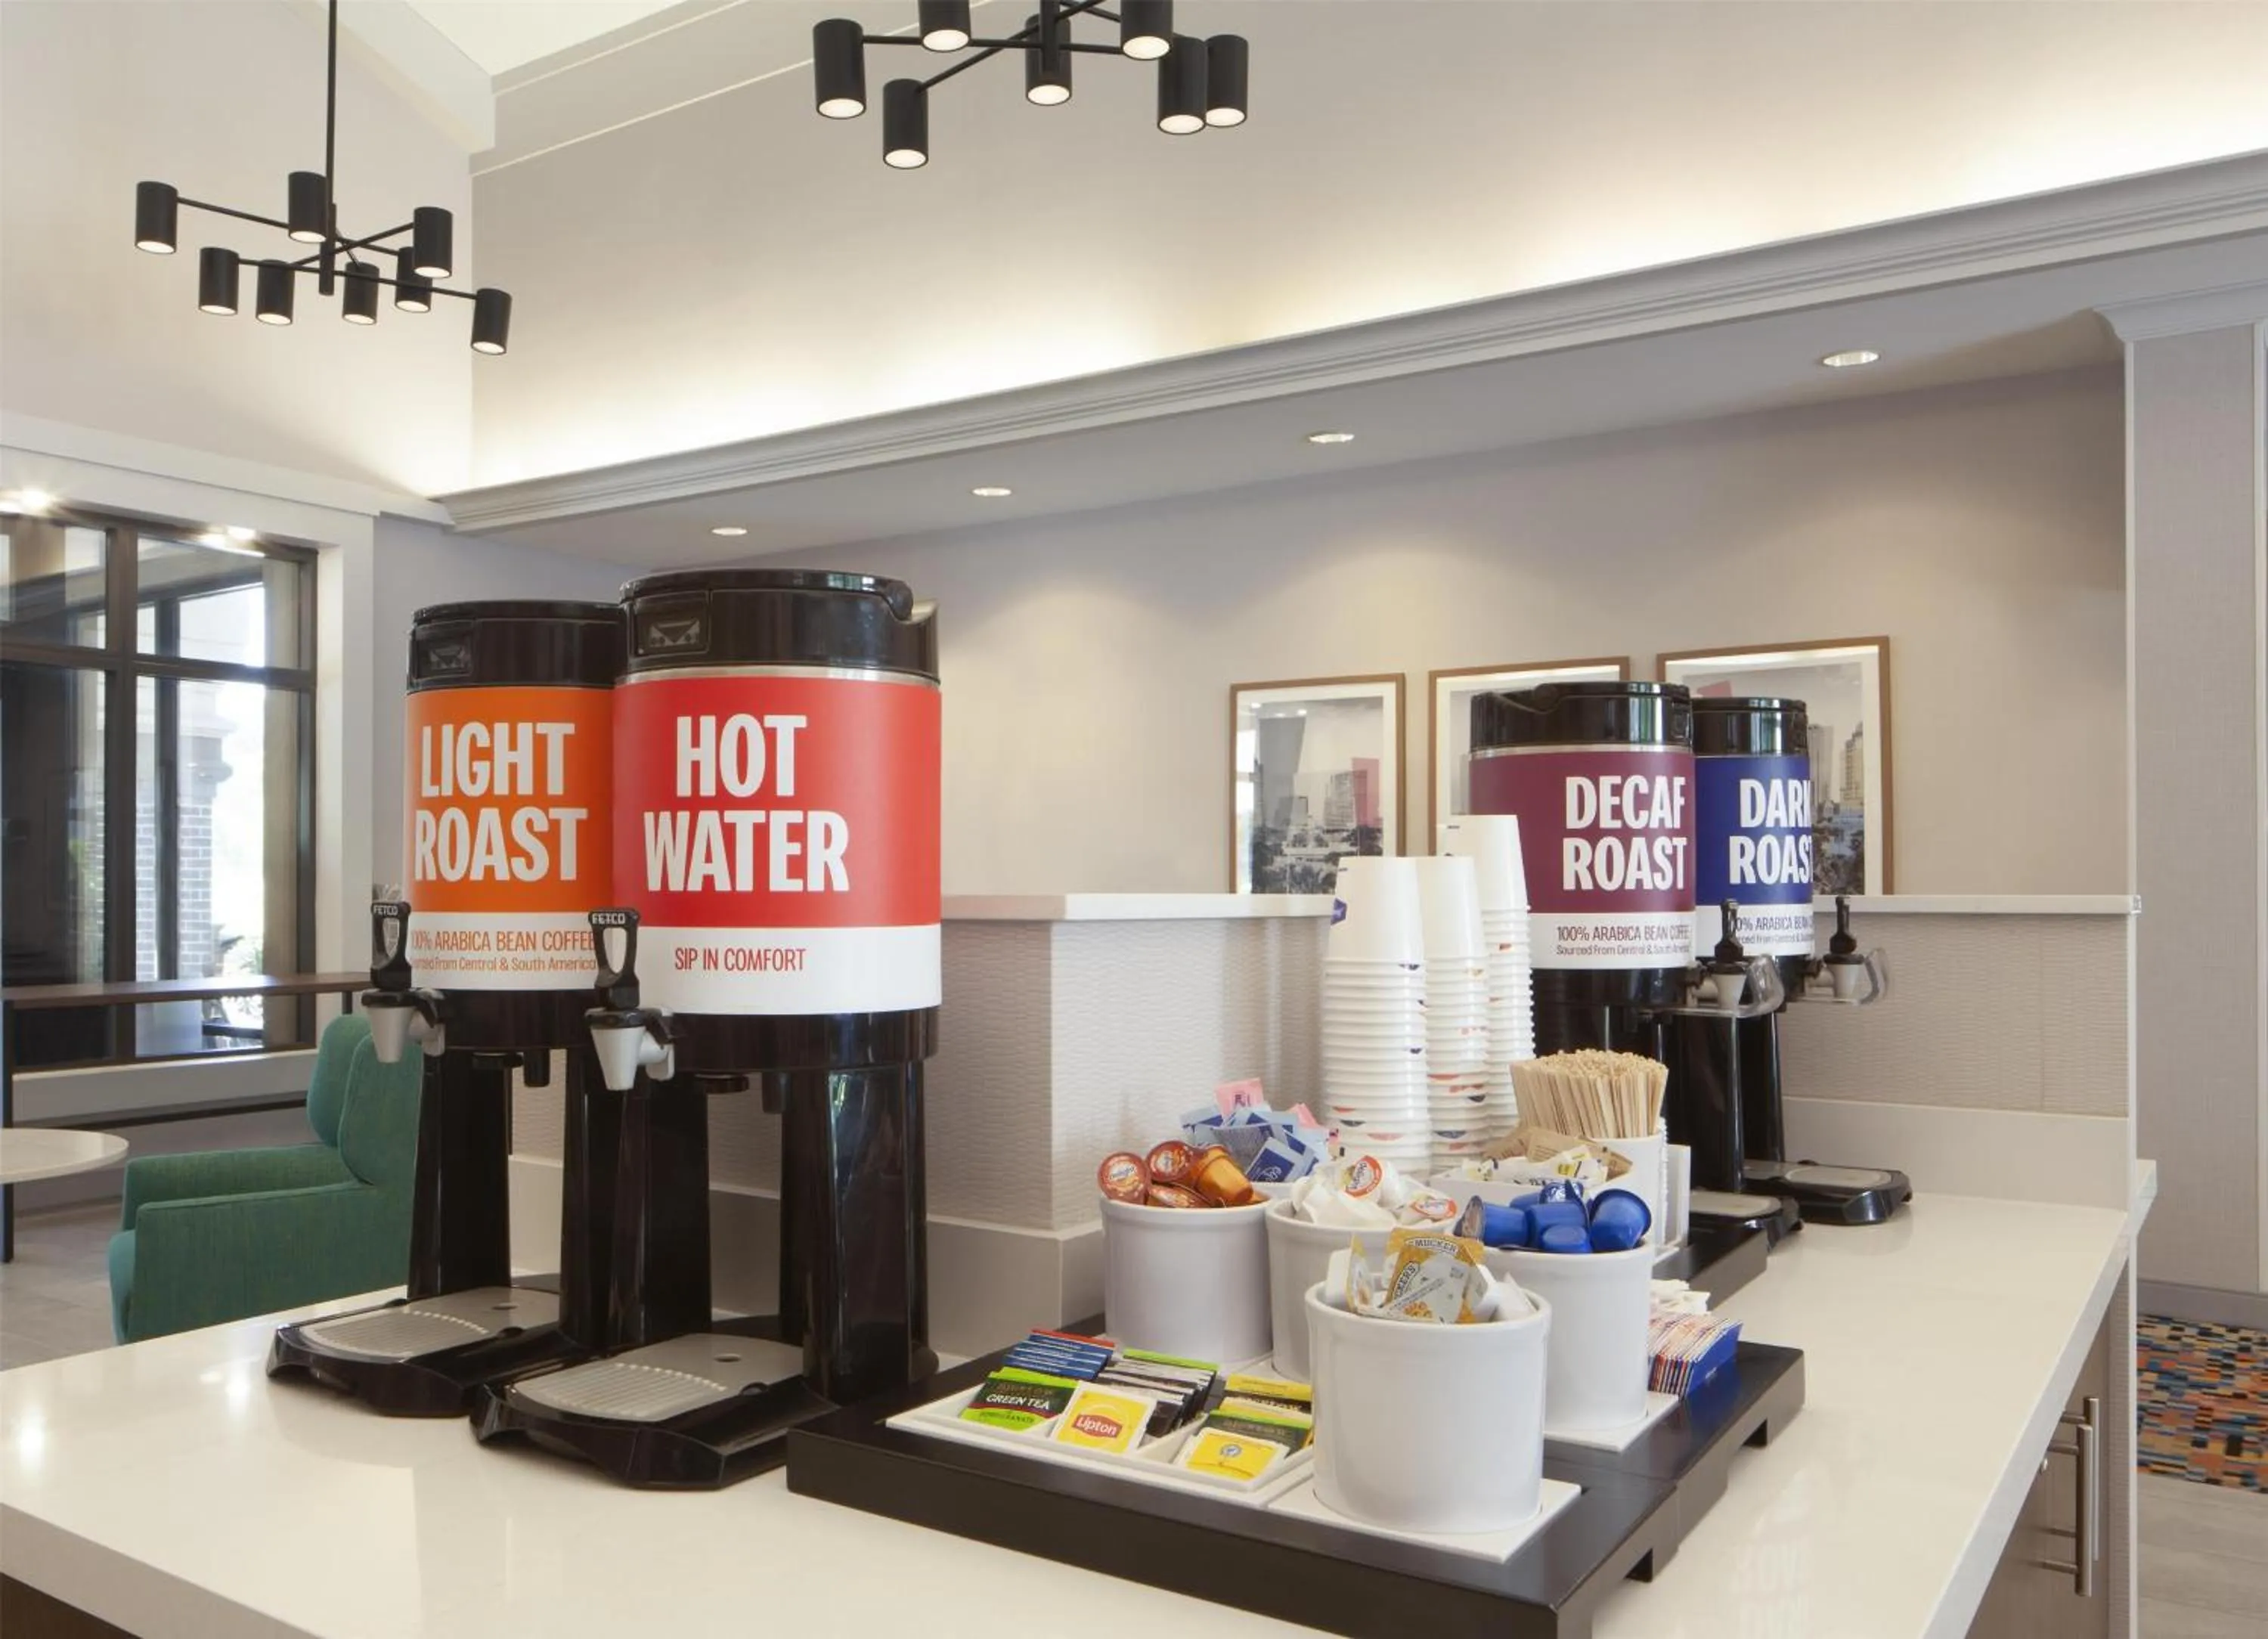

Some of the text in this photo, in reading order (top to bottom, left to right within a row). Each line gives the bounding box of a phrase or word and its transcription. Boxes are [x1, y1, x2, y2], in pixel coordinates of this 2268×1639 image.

[421, 722, 575, 797] LIGHT
[676, 714, 807, 797] HOT
[1566, 775, 1686, 829] DECAF
[414, 807, 588, 882] ROAST
[643, 810, 849, 892] WATER
[1563, 836, 1687, 891] ROAST
[373, 905, 398, 916] FETCO
[592, 912, 626, 925] FETCO
[1557, 926, 1589, 941] 100%
[1593, 926, 1641, 940] ARABICA
[1644, 925, 1668, 940] BEAN
[1755, 916, 1792, 931] ARABICA
[435, 931, 491, 951] ARABICA
[496, 931, 537, 951] BEAN
[1557, 945, 1592, 956] Sourced
[1594, 945, 1616, 956] From
[459, 957, 496, 971] Central
[500, 957, 510, 971] &
[512, 957, 545, 971] South
[675, 947, 806, 971] SIP IN COMFORT
[986, 1393, 1051, 1410] GREEN TEA
[1076, 1416, 1117, 1436] Lipton
